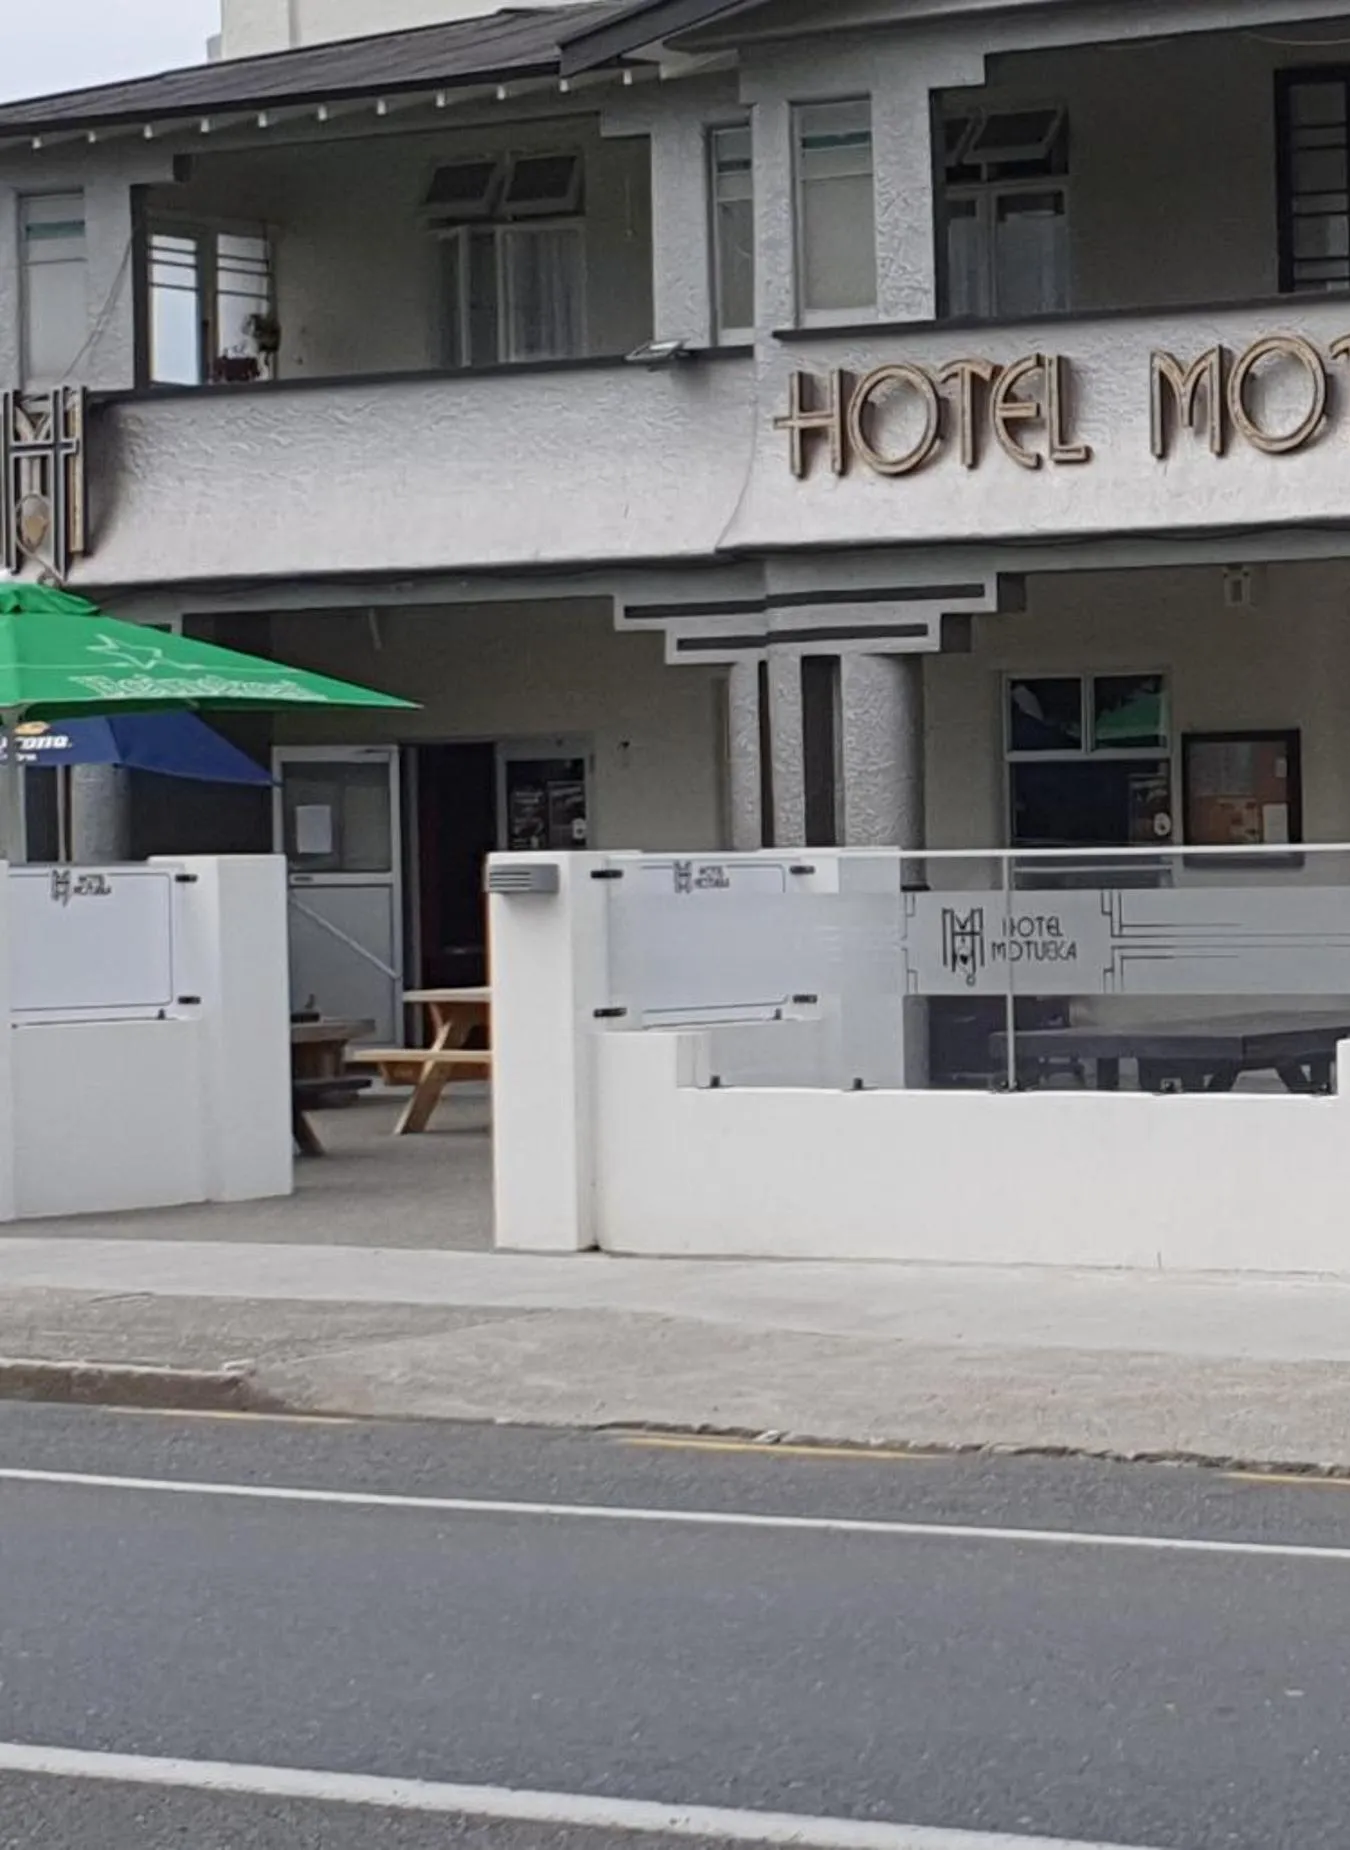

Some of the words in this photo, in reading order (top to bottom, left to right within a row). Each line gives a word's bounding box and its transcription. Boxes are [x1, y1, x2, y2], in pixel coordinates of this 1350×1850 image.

[773, 353, 1091, 478] HOTEL
[1002, 915, 1063, 938] HOTEL
[990, 939, 1078, 963] MOTUEKA
